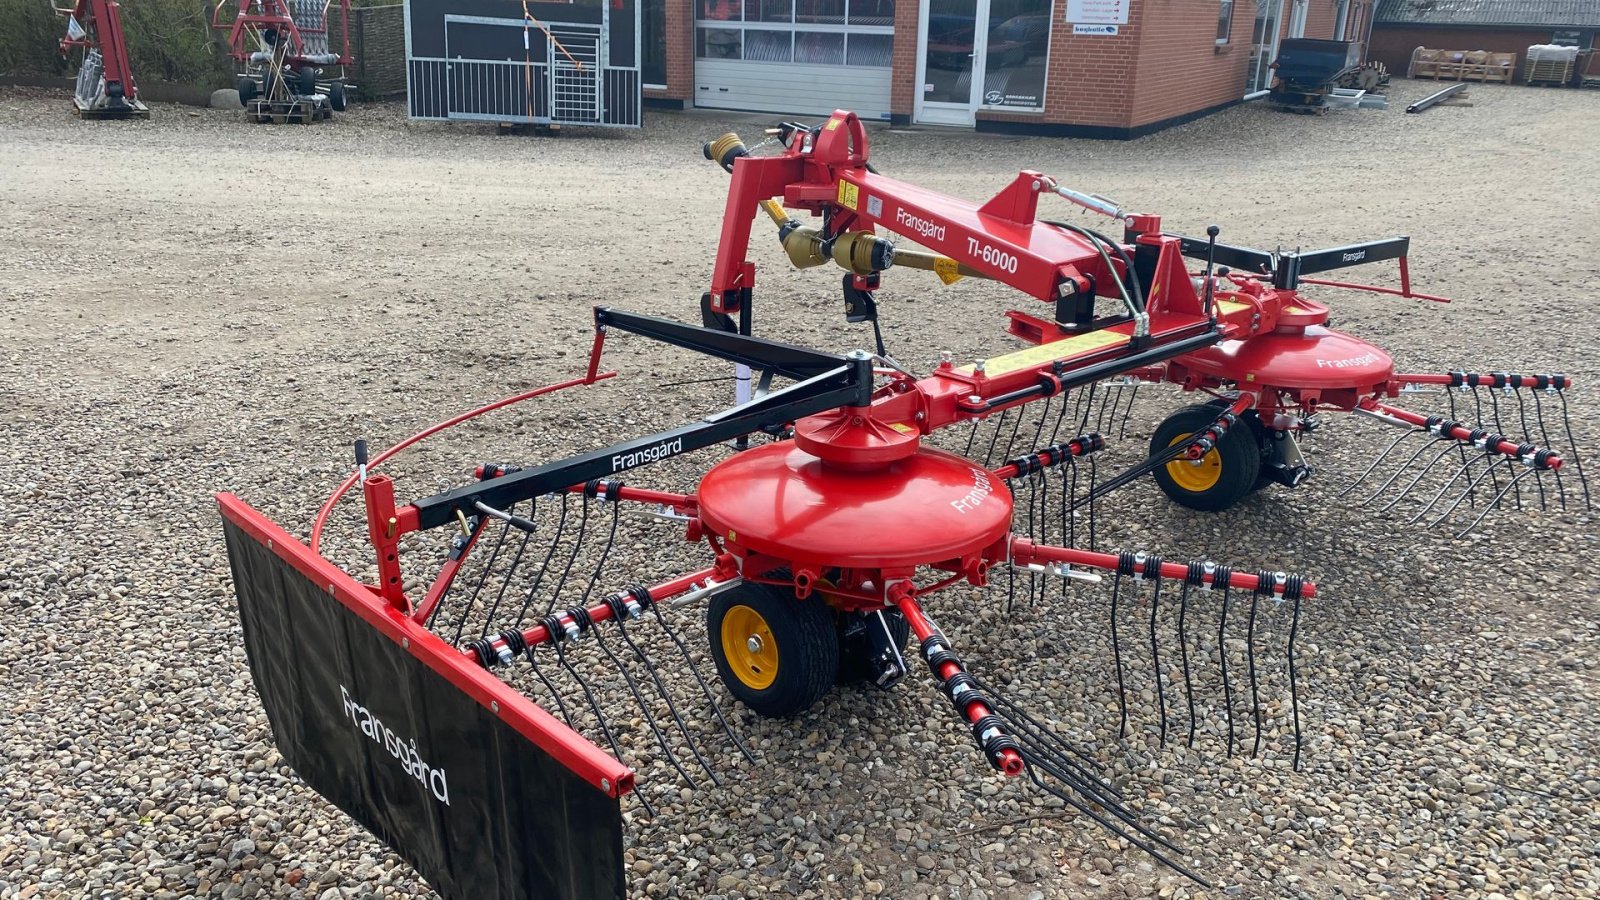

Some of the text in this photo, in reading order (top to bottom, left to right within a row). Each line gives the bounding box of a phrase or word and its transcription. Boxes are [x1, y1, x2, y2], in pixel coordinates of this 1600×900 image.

[896, 207, 945, 242] Fransgård
[967, 236, 1018, 274] TI-6000
[1342, 250, 1366, 262] Fransgård
[612, 437, 682, 472] Fransgård
[950, 467, 993, 514] Fransgård
[340, 684, 450, 806] Fransgård
